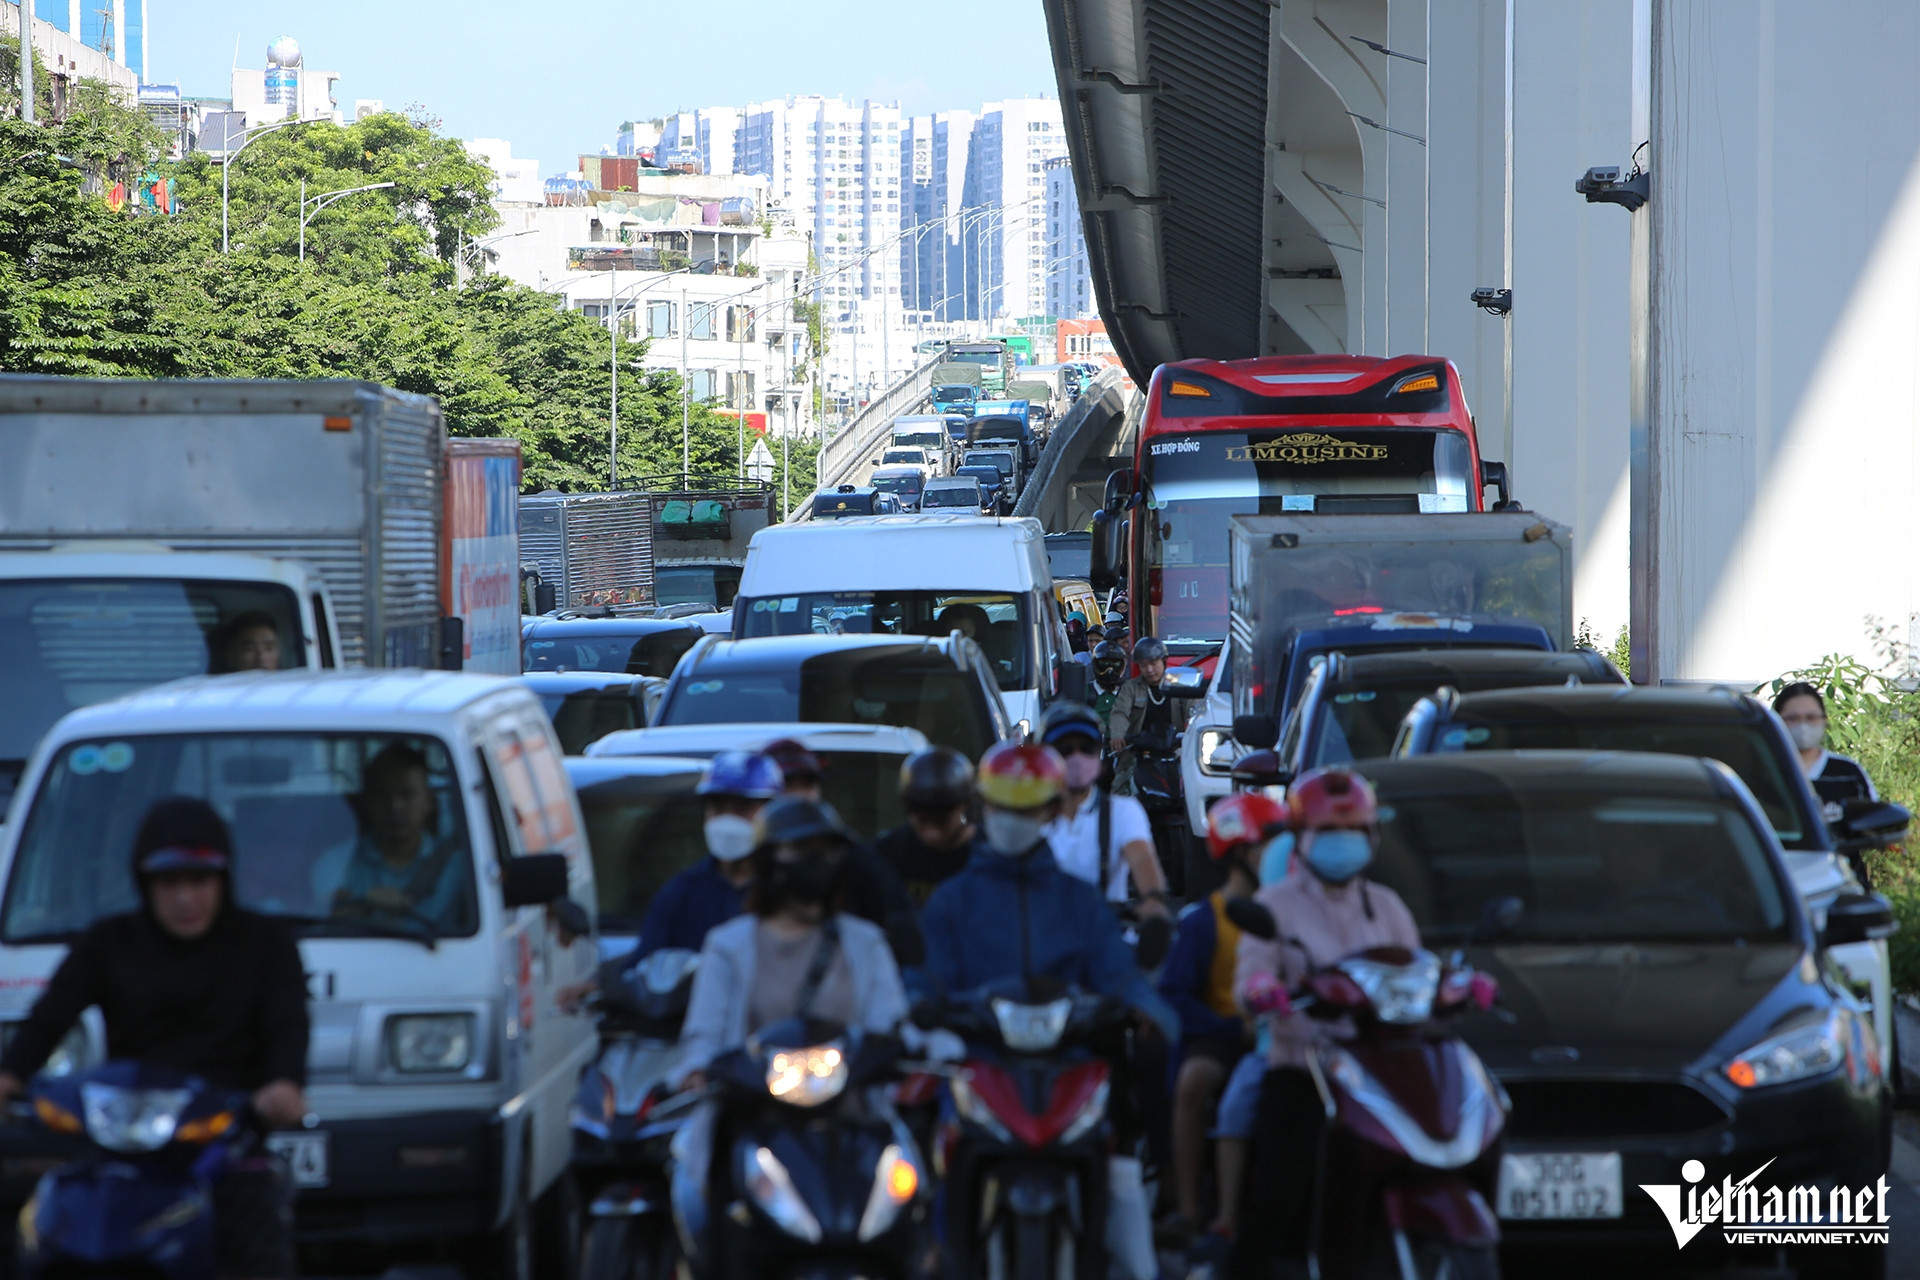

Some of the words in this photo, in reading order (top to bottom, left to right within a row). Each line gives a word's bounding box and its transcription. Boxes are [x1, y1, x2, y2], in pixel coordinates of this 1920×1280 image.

[1297, 435, 1317, 443] VIP
[1150, 444, 1161, 455] XE
[1177, 437, 1201, 452] ĐỒNG
[1225, 447, 1388, 459] LIMOUSINE
